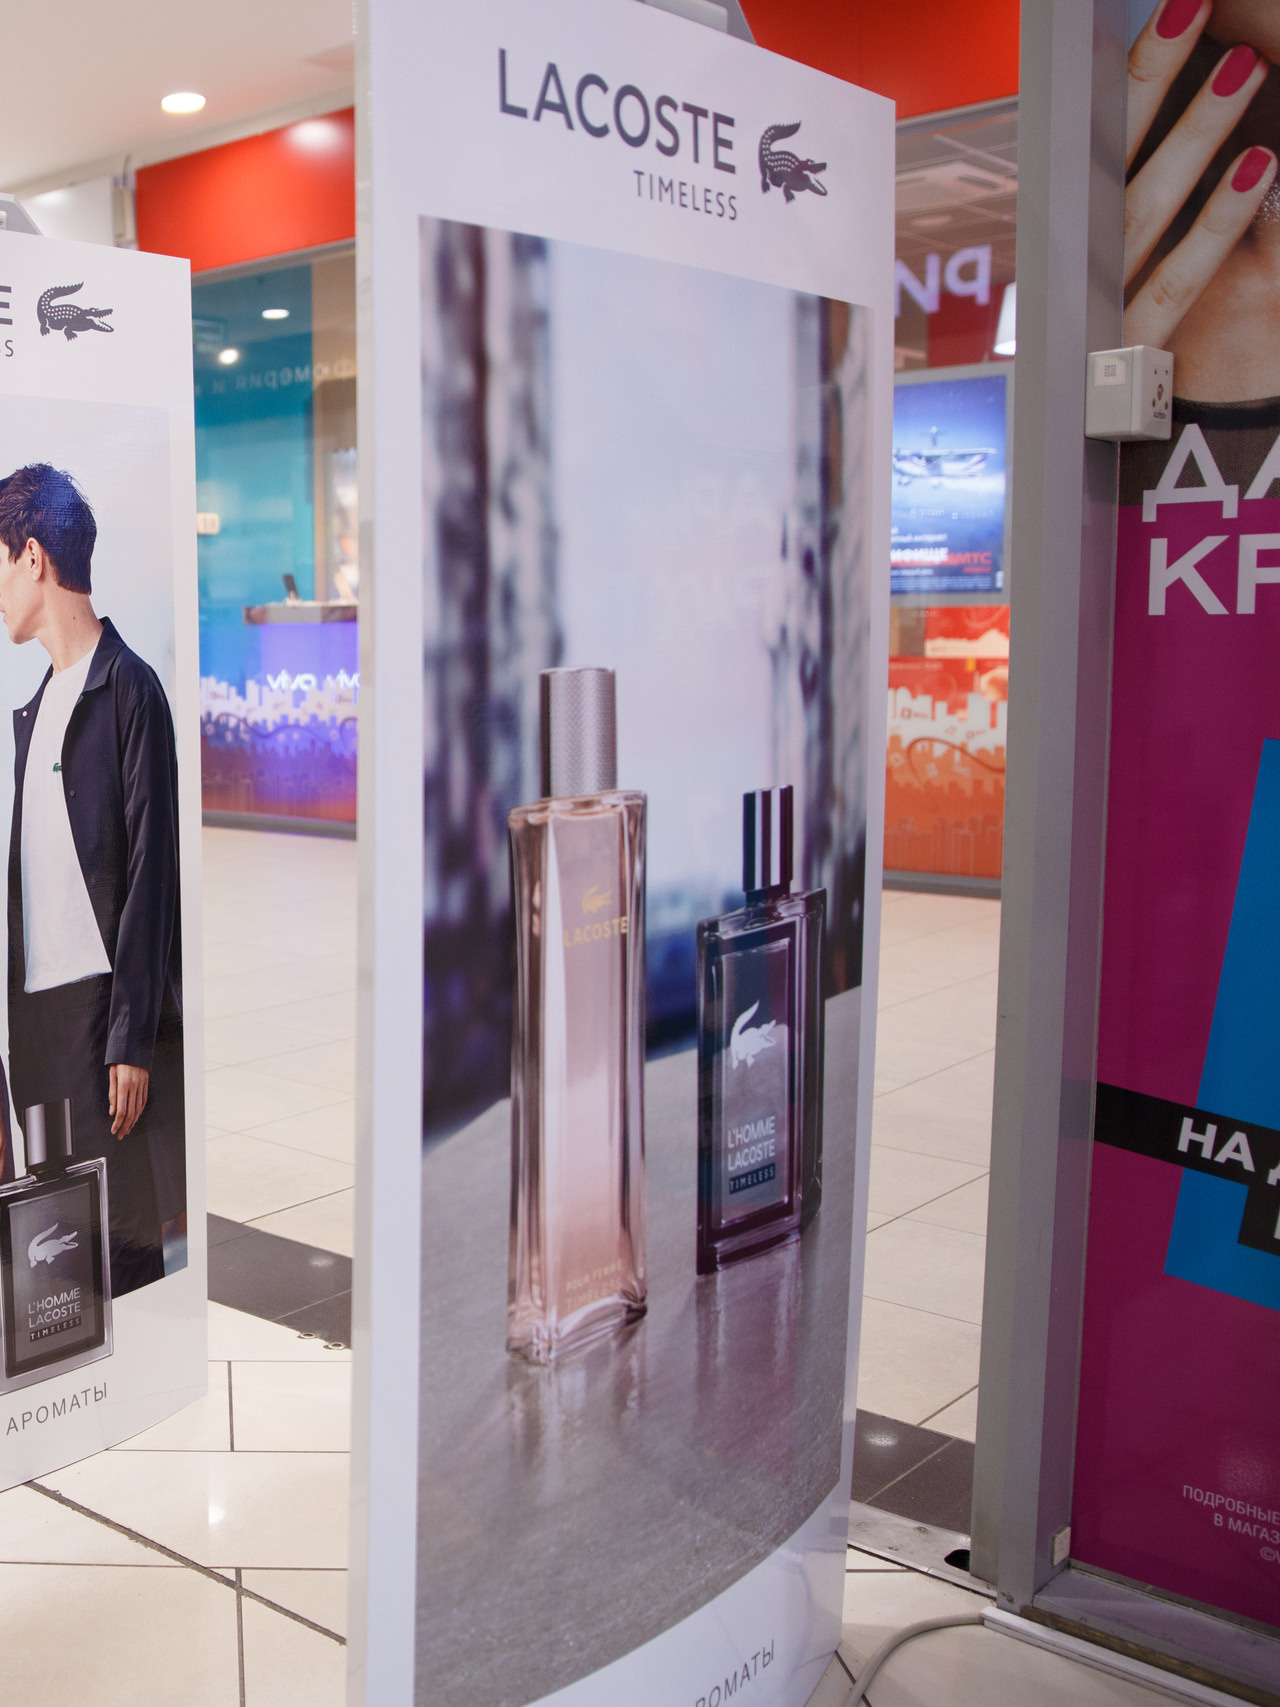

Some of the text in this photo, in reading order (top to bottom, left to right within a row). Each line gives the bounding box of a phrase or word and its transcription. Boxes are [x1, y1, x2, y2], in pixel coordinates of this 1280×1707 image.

[498, 47, 737, 175] LACOSTE
[633, 169, 738, 221] TIMELESS
[564, 915, 629, 949] LACOSTE
[727, 1115, 776, 1149] L'HOMME
[1177, 1116, 1256, 1173] НА
[727, 1138, 776, 1172] LACOSTE
[729, 1166, 775, 1192] TIMELESS
[28, 1287, 81, 1315] L'HOMME
[28, 1301, 81, 1329] LACOSTE
[31, 1317, 81, 1340] TIMELESS
[6, 1382, 108, 1436] АРОМАТЫ
[1183, 1485, 1280, 1525] ПОДРОБНЫЕ
[1214, 1513, 1280, 1544] В МАГАЗ
[695, 1639, 774, 1707] РОМАТЫ
